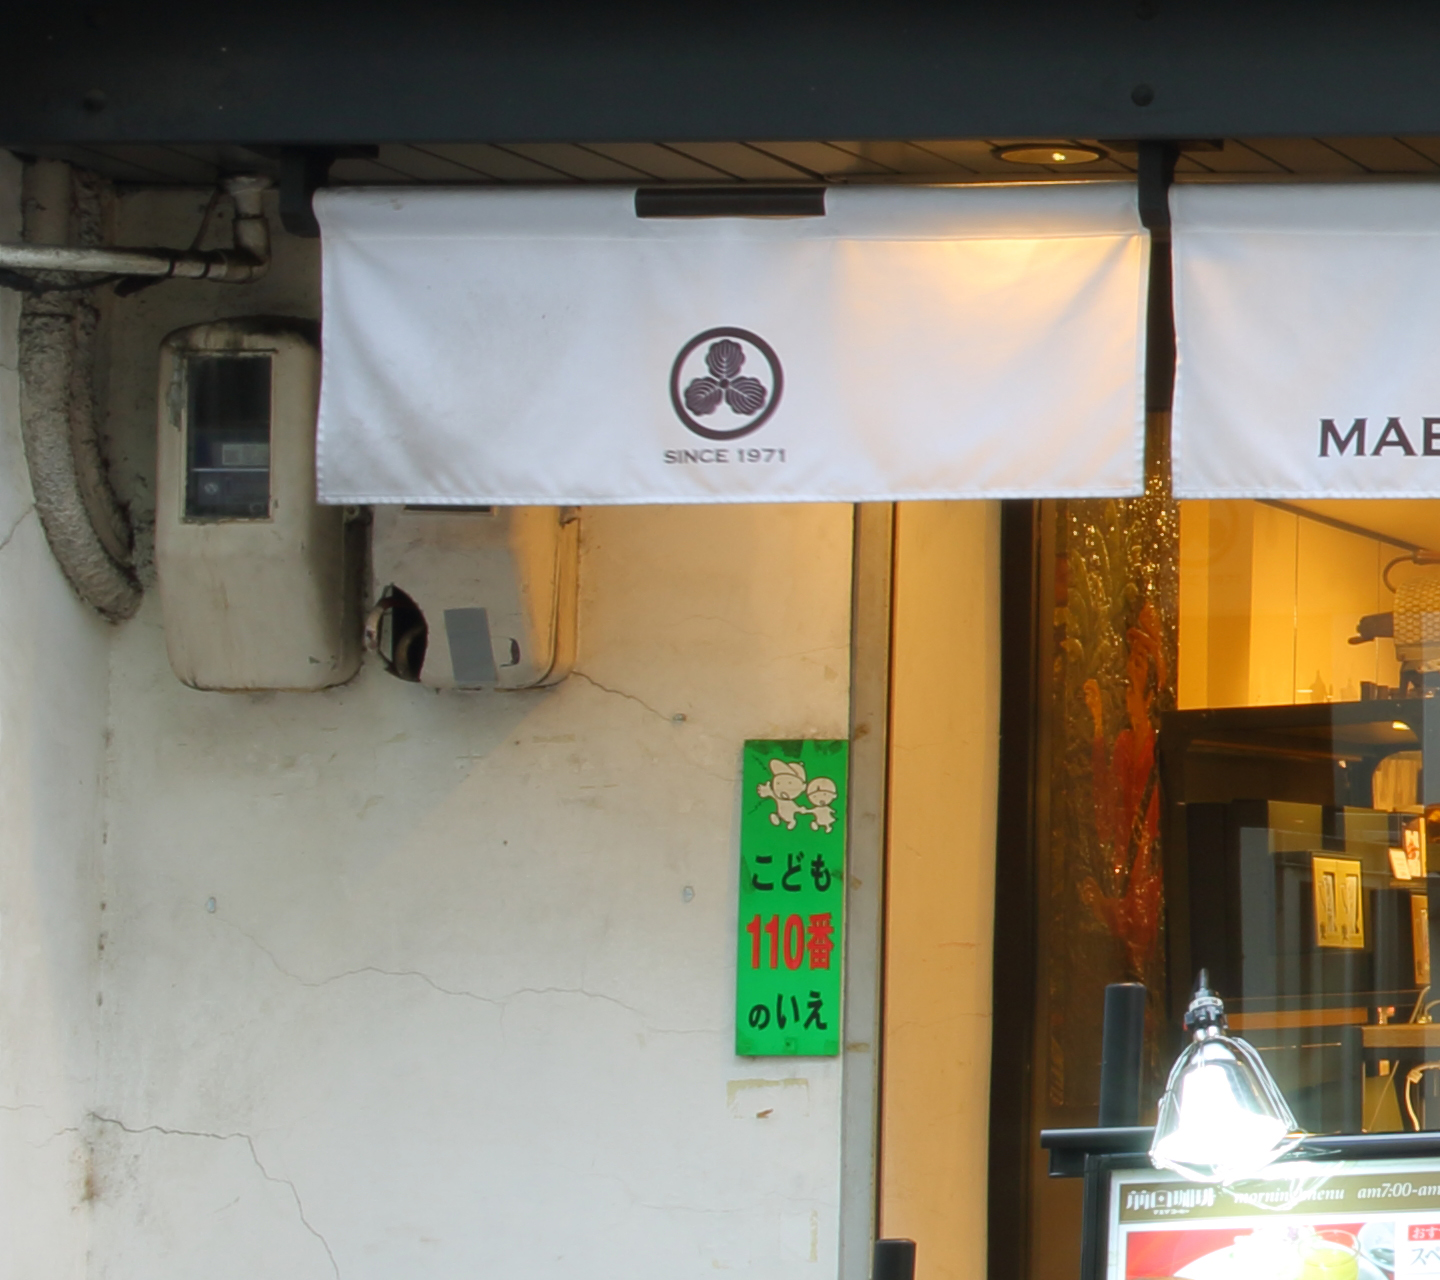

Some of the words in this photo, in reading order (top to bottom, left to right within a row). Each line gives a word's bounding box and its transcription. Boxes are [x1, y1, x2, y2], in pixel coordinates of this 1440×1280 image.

[663, 449, 729, 464] SINCE
[737, 448, 787, 463] 1971
[752, 851, 831, 892] こども
[746, 913, 835, 971] 110番
[748, 990, 828, 1031] のいえ
